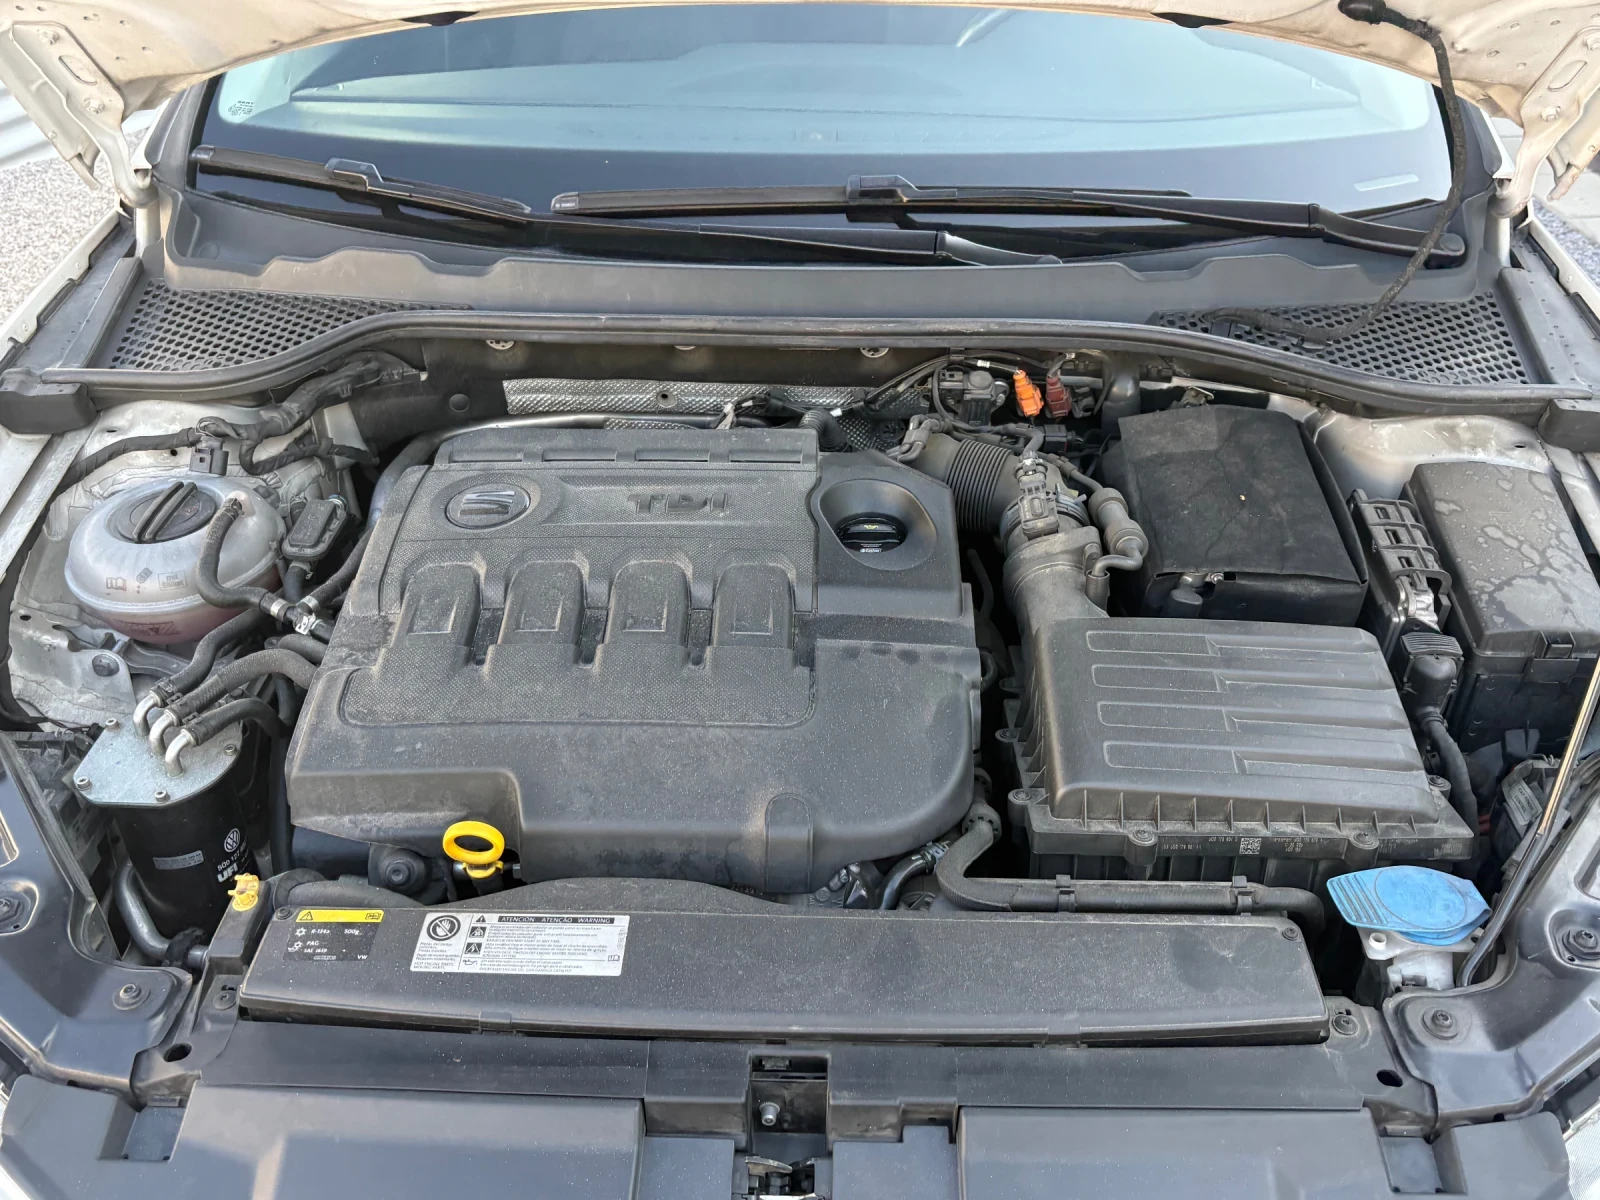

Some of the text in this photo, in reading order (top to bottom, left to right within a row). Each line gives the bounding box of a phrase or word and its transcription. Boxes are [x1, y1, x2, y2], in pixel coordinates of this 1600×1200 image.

[626, 492, 728, 514] TDI
[501, 915, 535, 923] ATENCIÓN
[541, 916, 573, 924] ATENÇÃO
